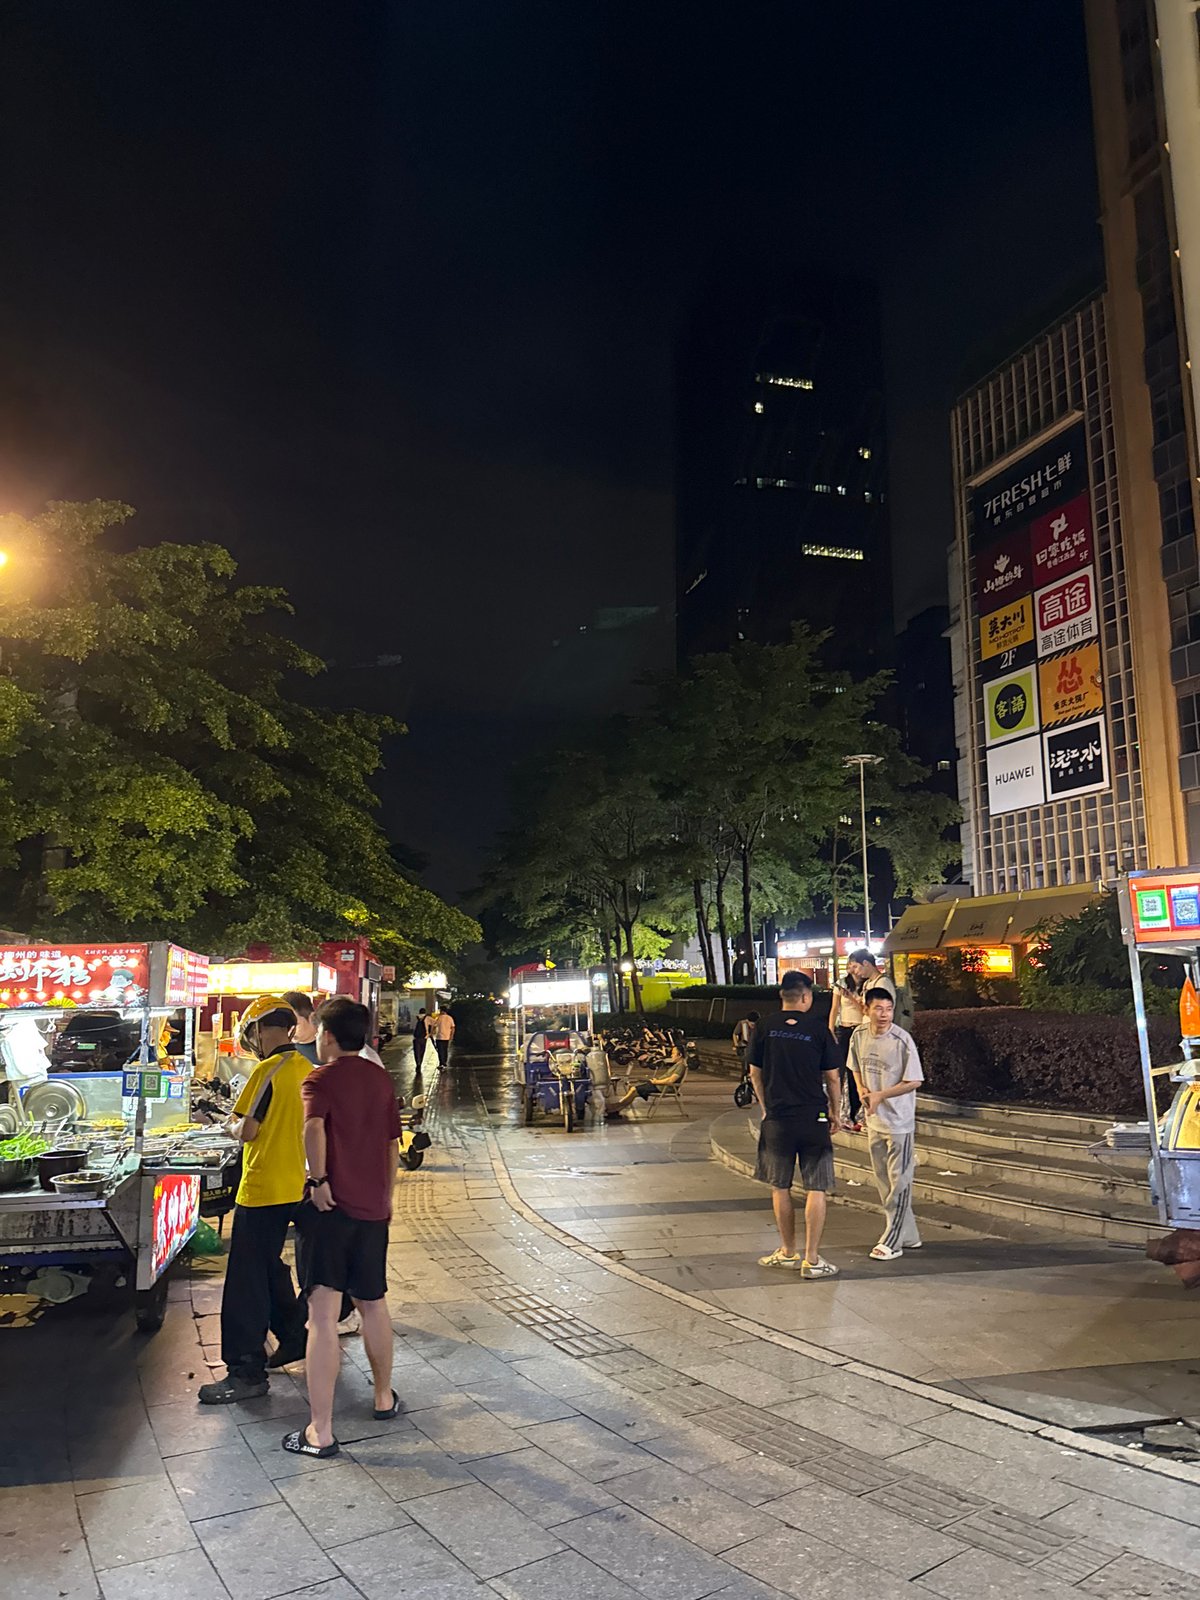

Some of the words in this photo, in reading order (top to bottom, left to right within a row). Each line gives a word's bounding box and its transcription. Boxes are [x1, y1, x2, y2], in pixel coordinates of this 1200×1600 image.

[1079, 550, 1089, 562] 5F
[1041, 582, 1088, 627] 高途
[988, 604, 1025, 638] 莫大川
[1041, 616, 1093, 652] 高途体育
[1000, 648, 1017, 669] 2F
[995, 765, 1035, 786] HUAWEI
